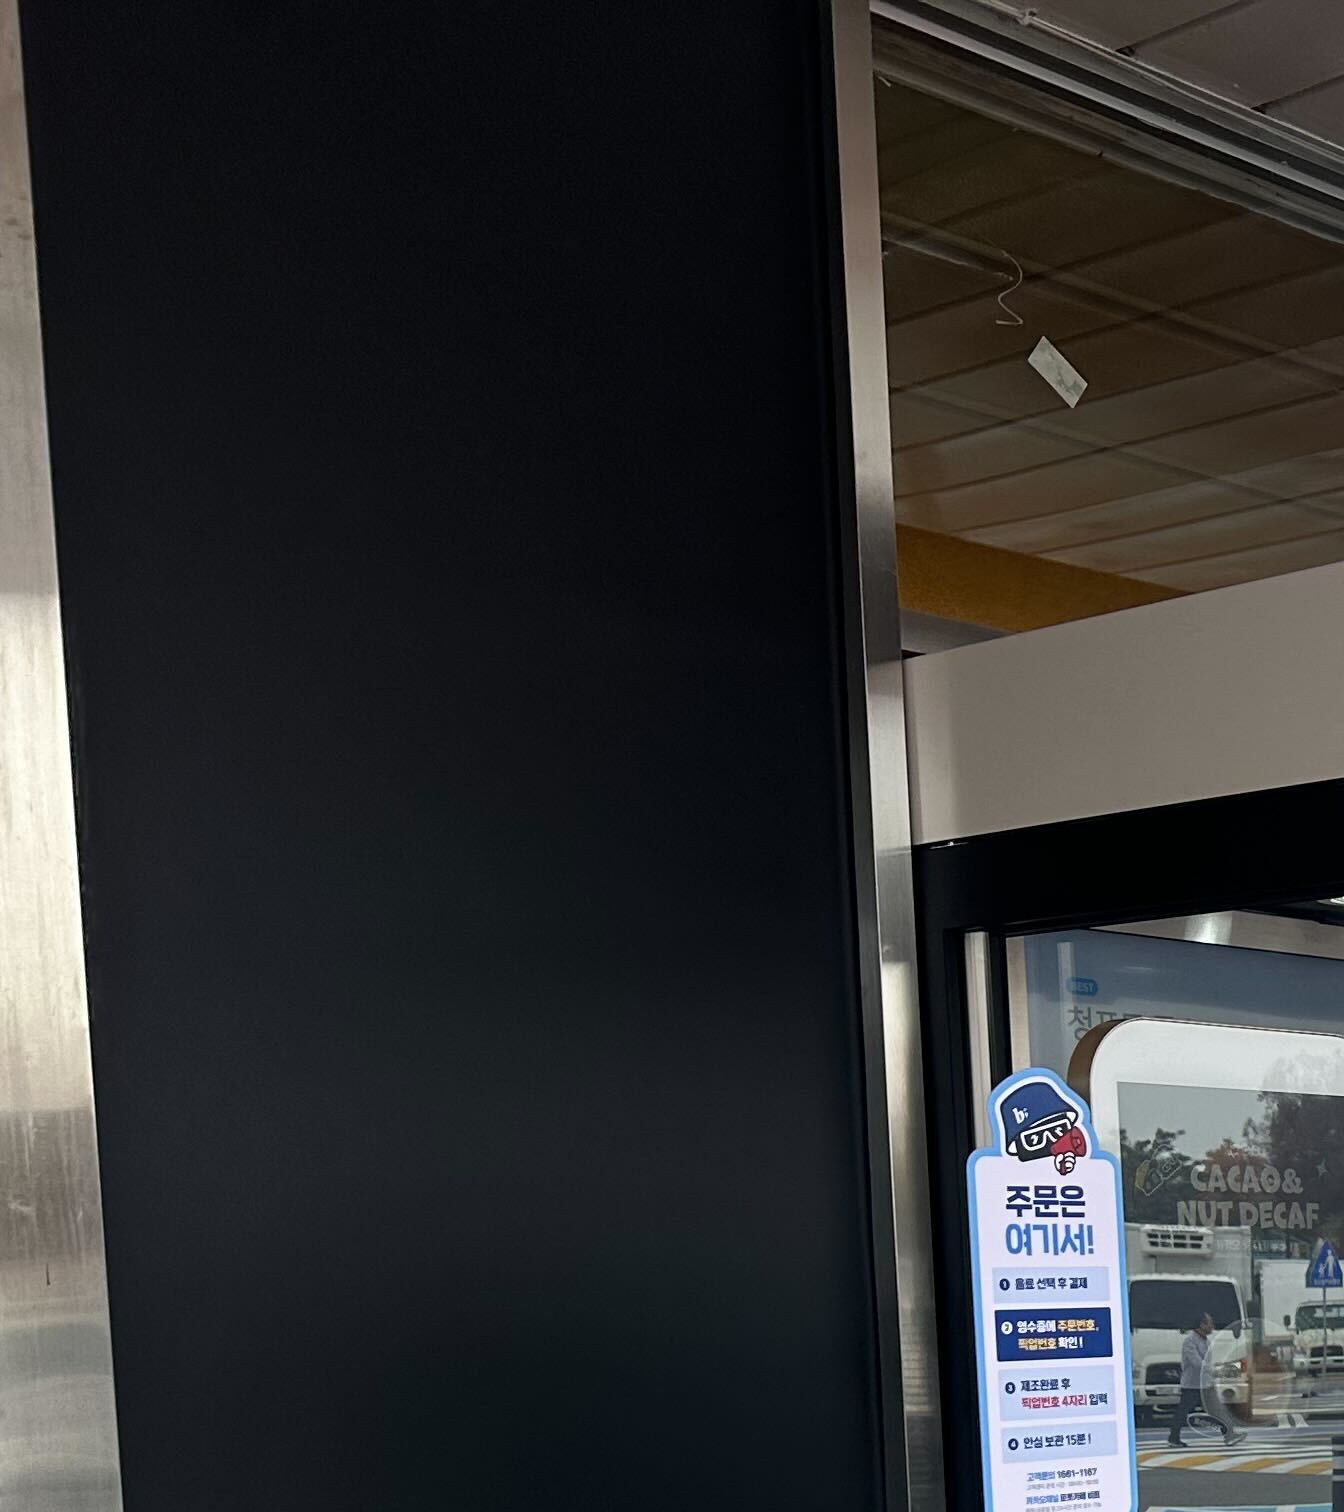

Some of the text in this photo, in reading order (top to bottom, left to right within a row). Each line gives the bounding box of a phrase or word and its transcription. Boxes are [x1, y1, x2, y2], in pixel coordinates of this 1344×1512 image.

[1005, 1185, 1087, 1218] 주문은
[1238, 1200, 1320, 1230] DECAF
[1005, 1223, 1095, 1256] 여기서!
[1036, 1277, 1056, 1290] 선택
[1017, 1320, 1056, 1333] 영수증에
[1020, 1378, 1059, 1392] 제조완료
[1061, 1378, 1071, 1390] 후
[1061, 1394, 1088, 1407] 4자리
[1089, 1392, 1108, 1405] 입력
[1023, 1437, 1043, 1449] 안심
[1044, 1435, 1064, 1448] 보관
